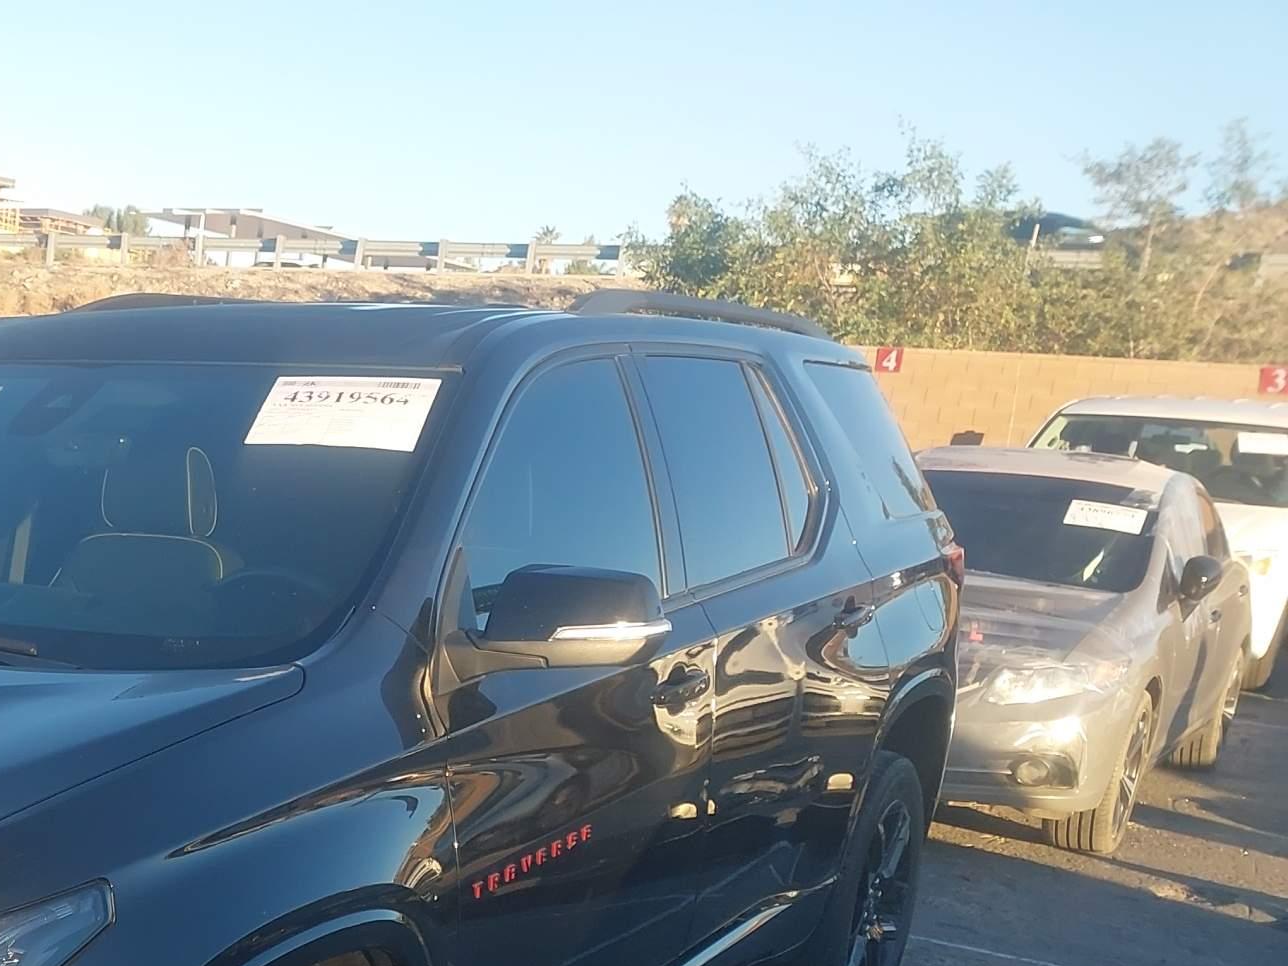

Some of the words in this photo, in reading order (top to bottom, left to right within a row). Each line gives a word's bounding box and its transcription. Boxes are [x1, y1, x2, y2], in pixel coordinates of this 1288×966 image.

[882, 349, 898, 371] 4
[1266, 368, 1287, 393] 3
[283, 390, 409, 406] 43919564
[471, 823, 594, 899] TRAVERSE
